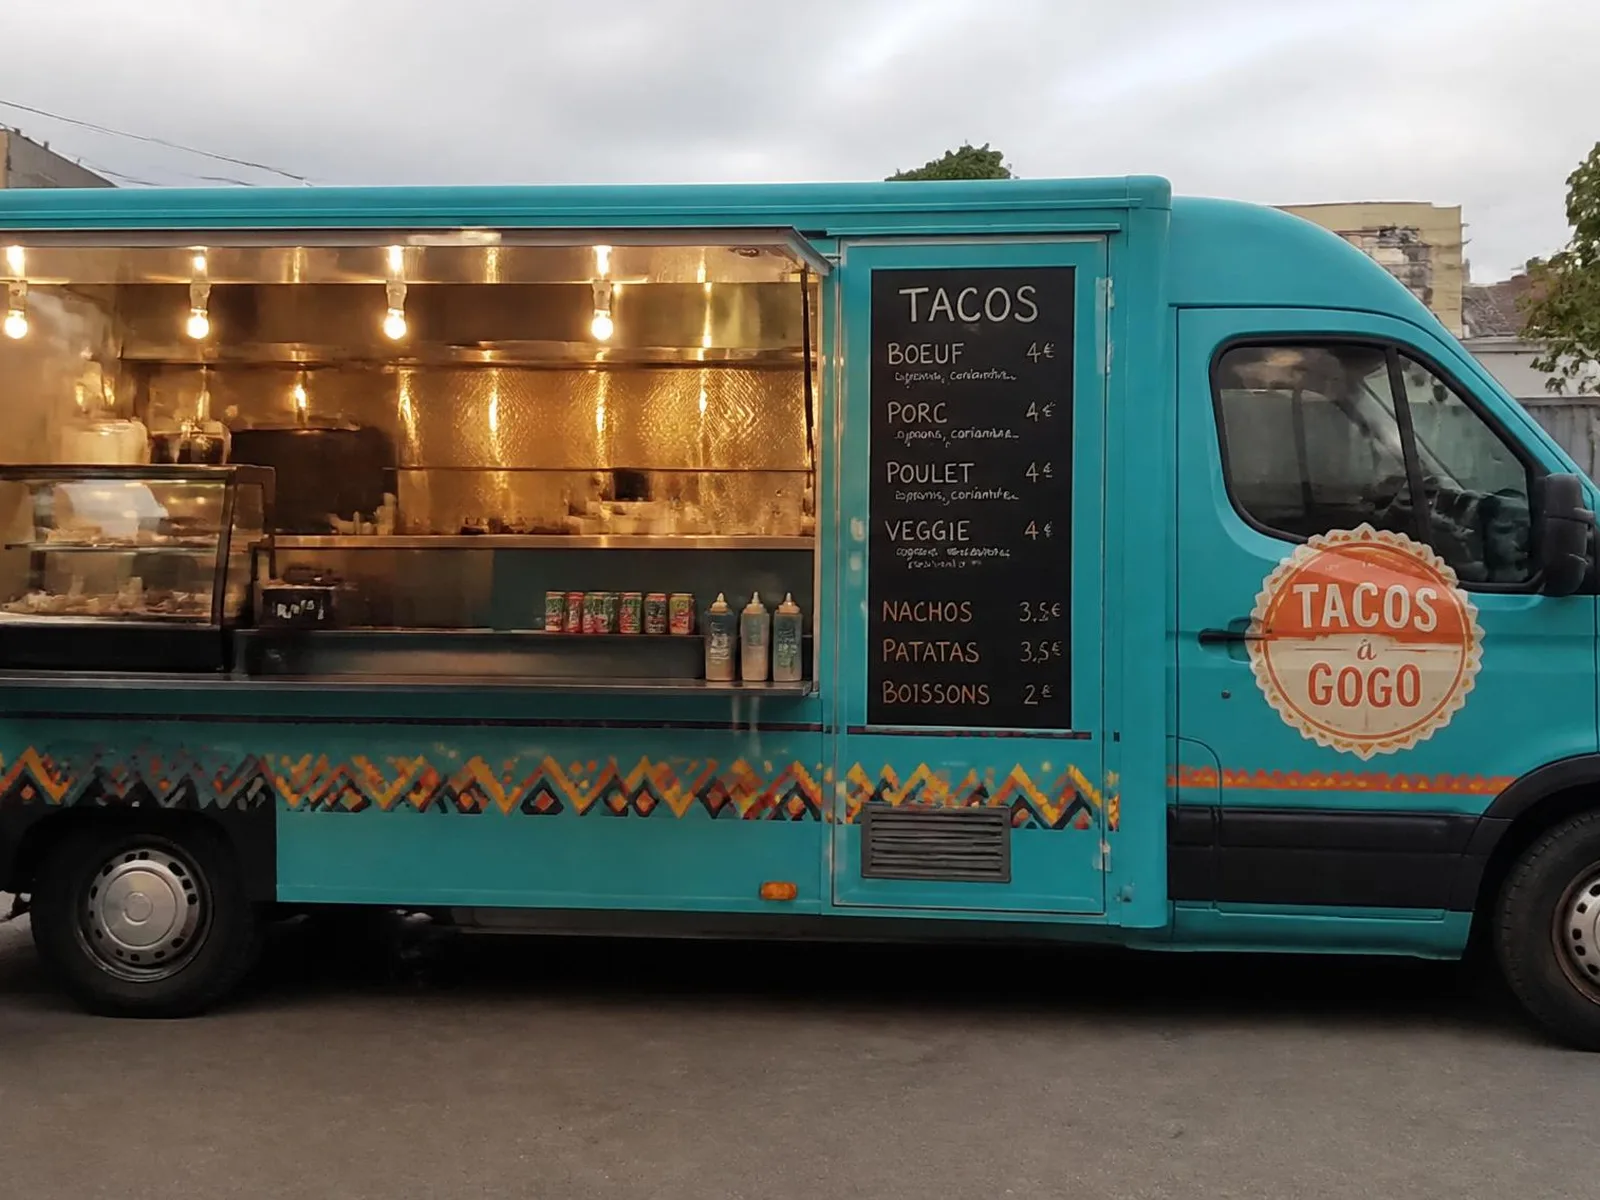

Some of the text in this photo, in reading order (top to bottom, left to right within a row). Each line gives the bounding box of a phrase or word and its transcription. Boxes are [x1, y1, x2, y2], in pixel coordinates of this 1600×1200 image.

[900, 285, 1039, 323] TACOS
[888, 343, 965, 365] BOEUF
[887, 402, 948, 424] PORC
[887, 462, 975, 484] POULET
[885, 520, 970, 542] VEGGIE
[882, 601, 973, 623] NACHOS
[1293, 582, 1438, 633] TACOS
[882, 638, 980, 663] PATATAS
[882, 680, 990, 706] BOISSONS
[1308, 663, 1421, 709] GOGO
